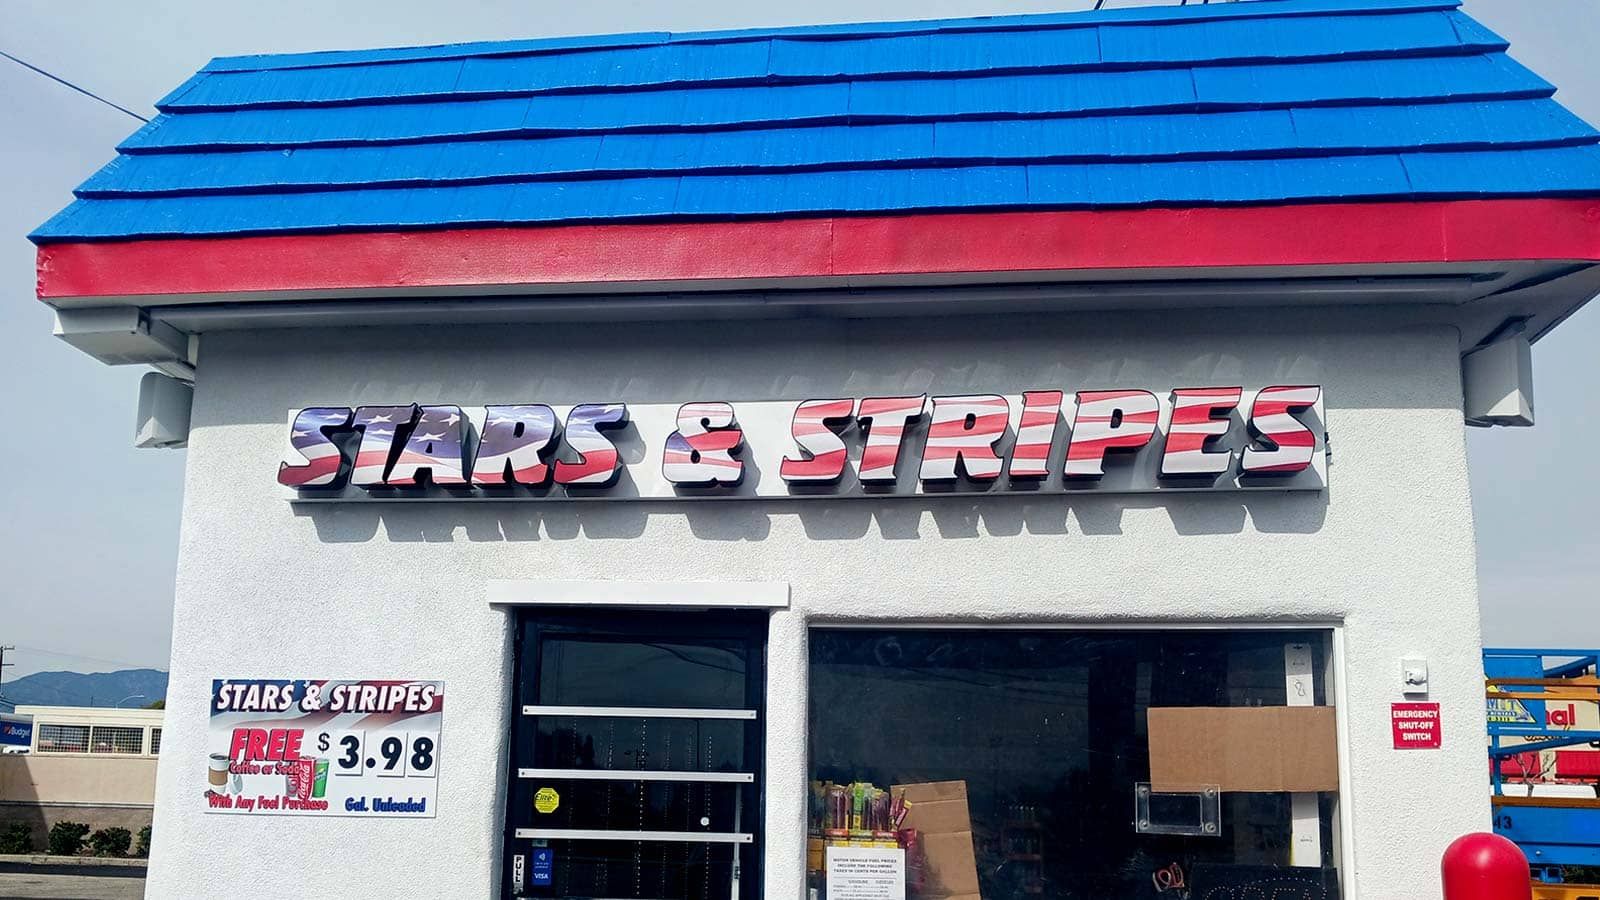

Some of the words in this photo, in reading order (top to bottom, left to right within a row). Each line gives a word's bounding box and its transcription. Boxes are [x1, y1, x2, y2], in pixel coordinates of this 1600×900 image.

[277, 401, 627, 489] STARS
[662, 400, 744, 486] &
[780, 385, 1321, 482] STRIPES
[216, 683, 294, 712] STARS
[301, 683, 322, 711] &
[330, 684, 436, 713] STRIPES
[1393, 709, 1438, 719] EMERGENCY
[1398, 721, 1434, 730] SHUT-OFF
[1402, 732, 1432, 741] SWITCH
[229, 728, 305, 762] FREE
[229, 760, 260, 776] Coffee
[262, 764, 274, 776] or
[275, 760, 301, 776] Soda
[208, 793, 233, 809] With
[234, 795, 256, 812] Any
[257, 794, 280, 810] Fuel
[281, 795, 329, 811] Purchase
[345, 797, 368, 812] Gal.
[372, 797, 426, 813] Unleaded
[534, 872, 549, 880] VISA
